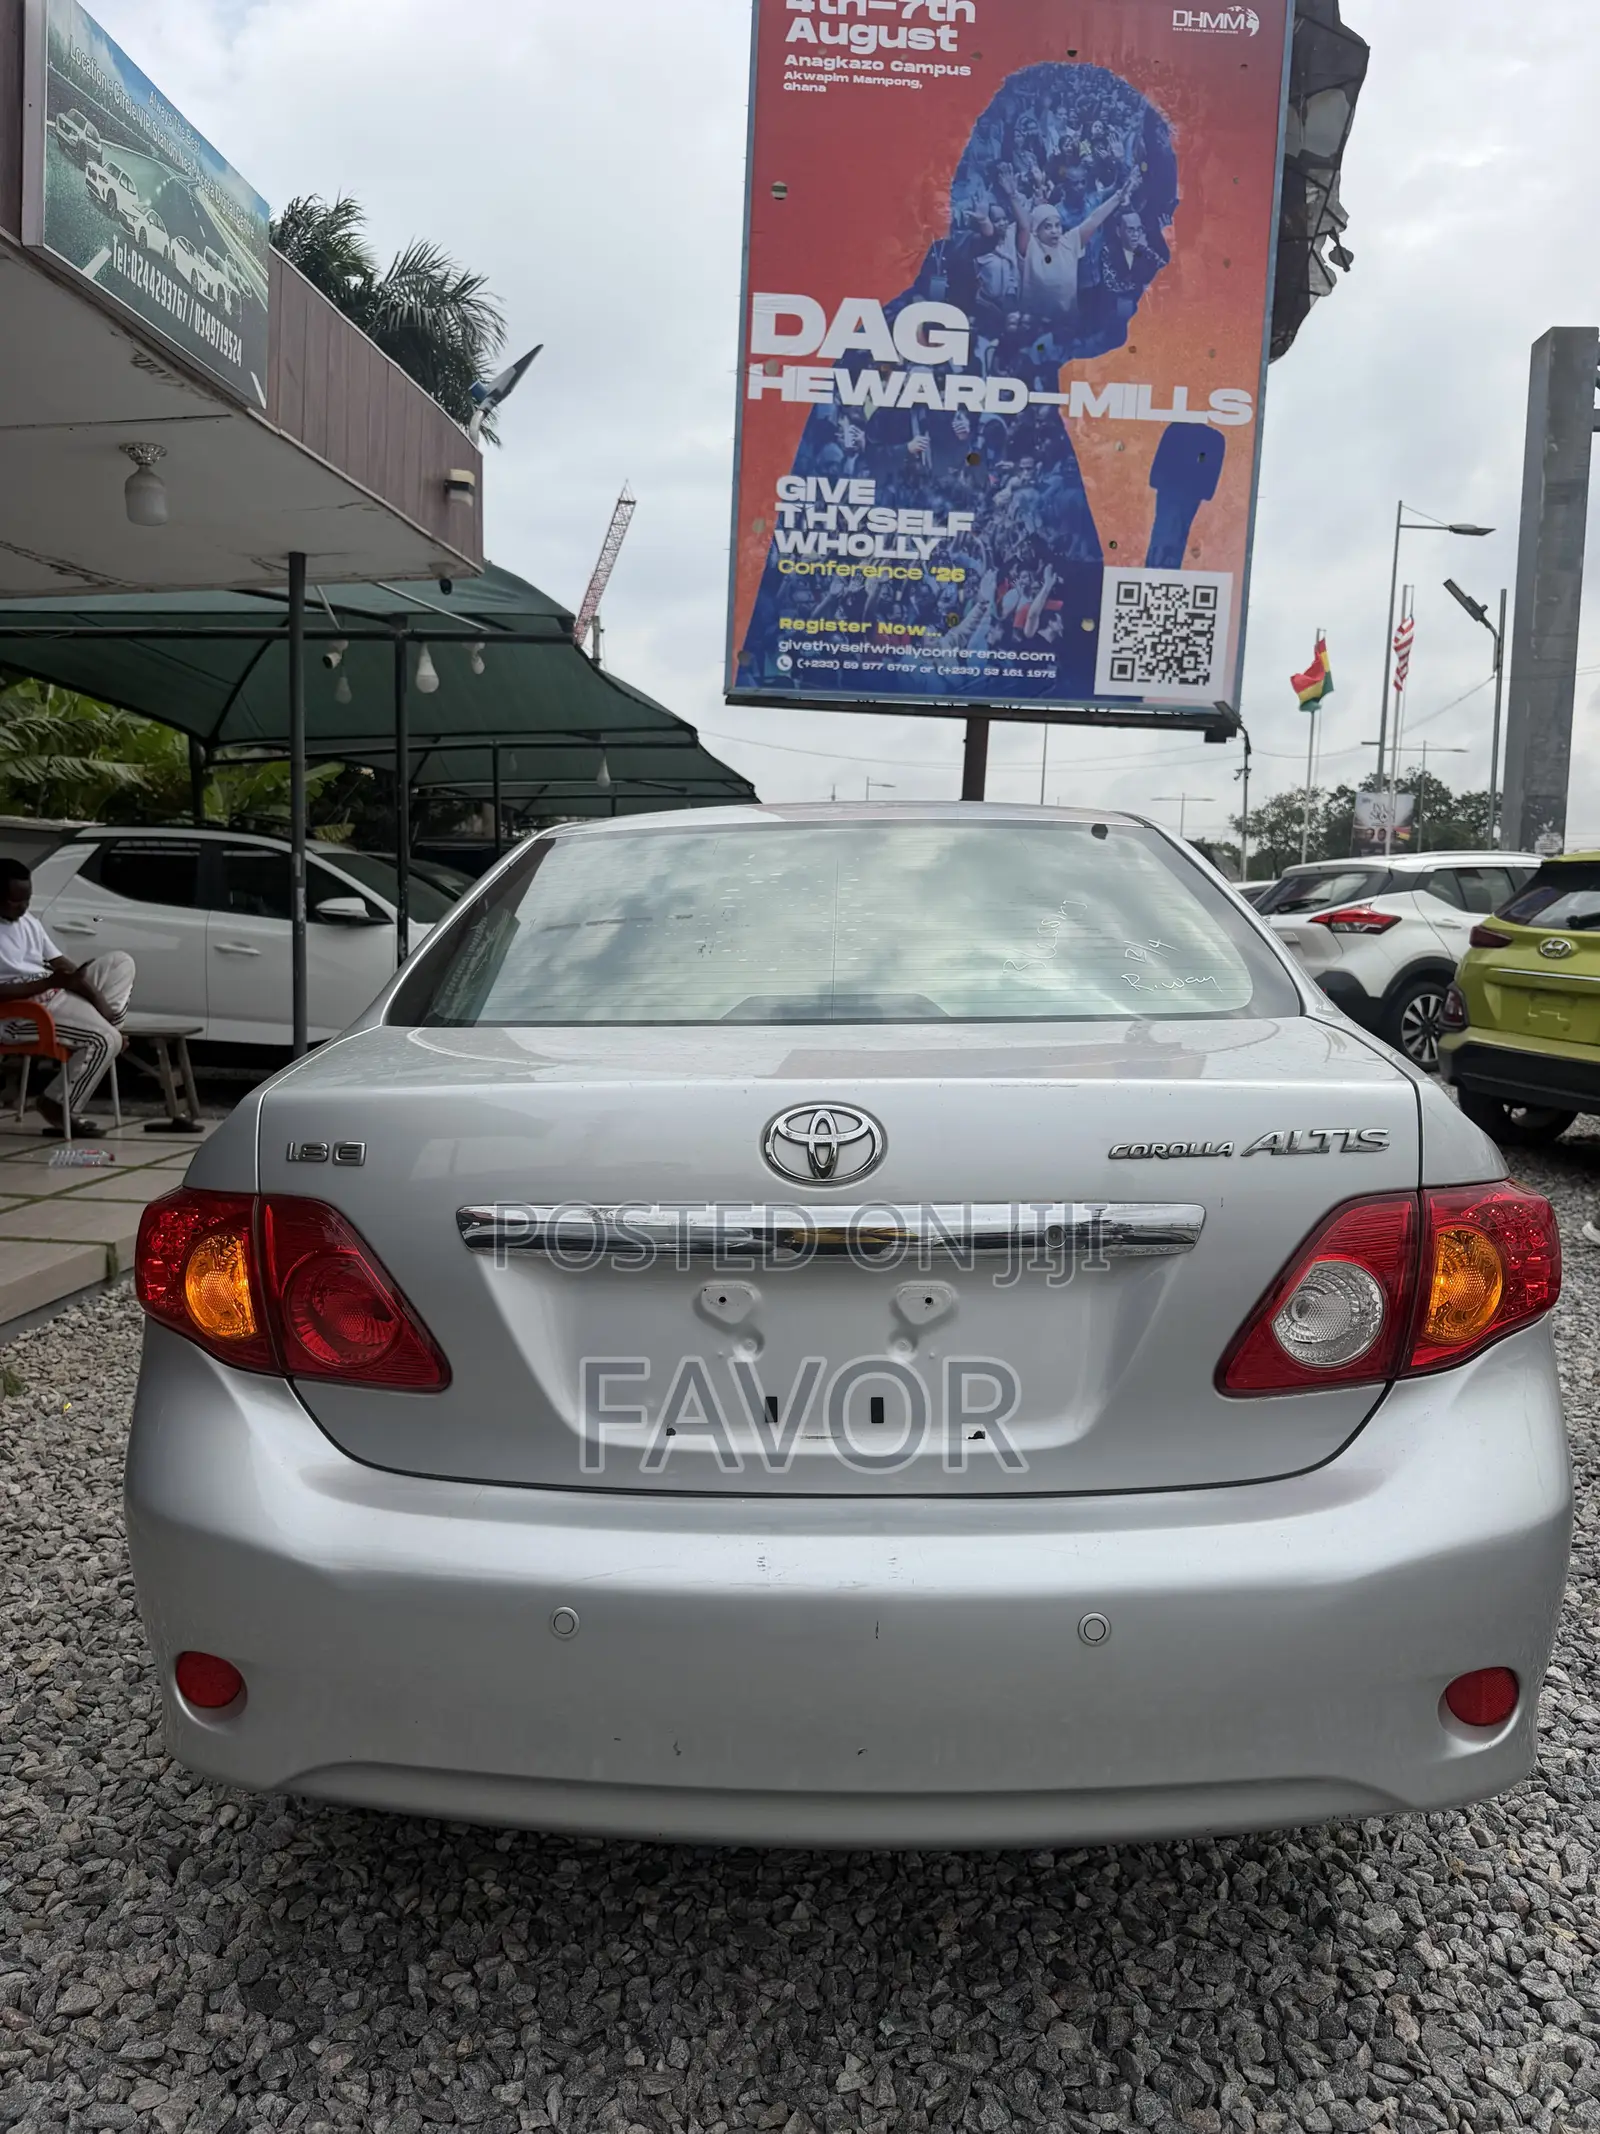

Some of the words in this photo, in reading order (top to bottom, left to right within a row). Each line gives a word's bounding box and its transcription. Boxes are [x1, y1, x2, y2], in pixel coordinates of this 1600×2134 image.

[1172, 10, 1245, 30] DHMM
[785, 17, 958, 54] August
[69, 34, 107, 92] Location
[114, 80, 137, 121] Circle
[784, 54, 885, 71] Anagkazo
[890, 60, 971, 78] Campus
[783, 81, 827, 93] Ghana
[784, 71, 849, 84] Akwapim
[853, 74, 923, 90] Mampong,
[749, 291, 971, 366] DAG
[776, 475, 876, 505] GIVE
[774, 502, 975, 537] THYSELF
[774, 529, 942, 561] WHOLLY
[777, 559, 923, 581] Conference
[779, 617, 872, 635] Register
[778, 639, 1056, 662] givethyselfwhollyconference.com
[796, 658, 841, 671] (+233)
[861, 662, 884, 671] 977
[919, 666, 935, 674] or
[937, 665, 981, 677] (+233)
[1107, 1141, 1235, 1160] COROLLA
[1240, 1127, 1391, 1157] ALTIS
